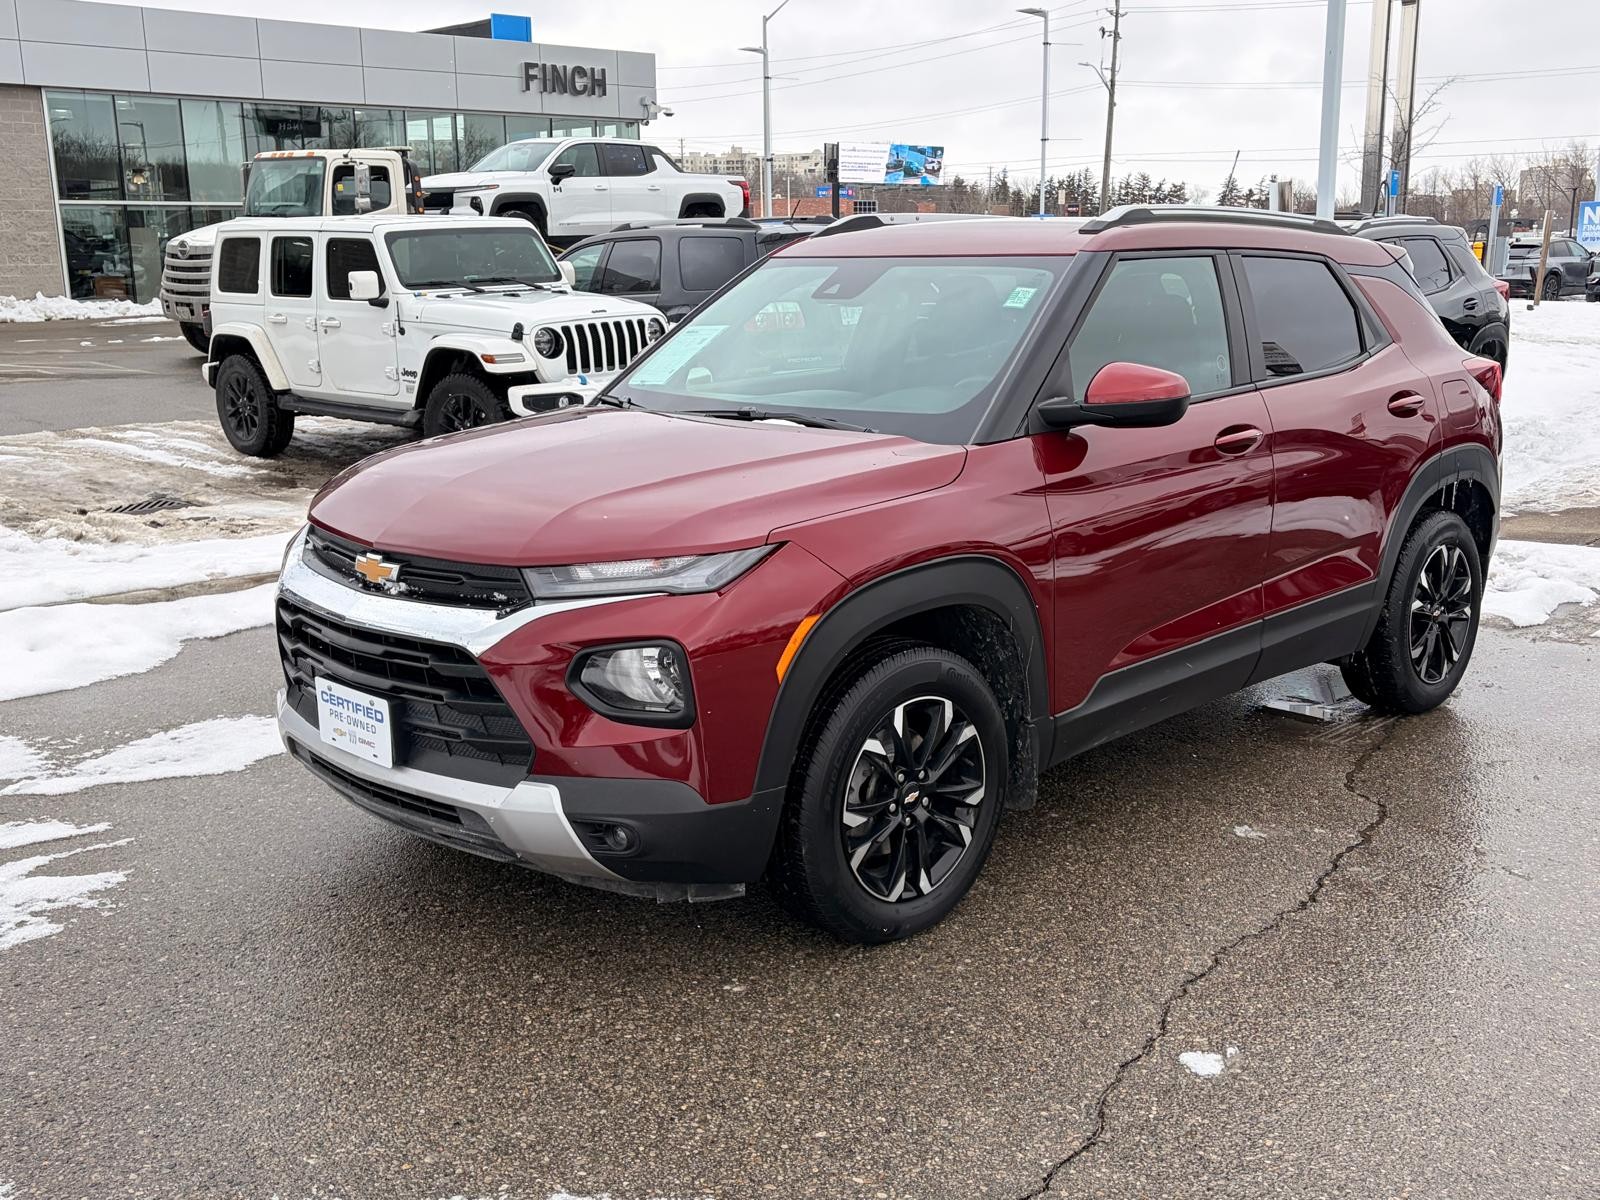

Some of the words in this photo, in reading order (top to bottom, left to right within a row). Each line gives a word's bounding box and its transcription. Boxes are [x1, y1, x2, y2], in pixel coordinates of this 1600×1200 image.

[521, 61, 607, 97] FINCH
[1583, 206, 1600, 224] N
[401, 368, 418, 379] Jeep
[320, 690, 384, 724] CERTIFIED
[329, 708, 377, 735] PRE-OWNED
[358, 737, 376, 749] GMC
